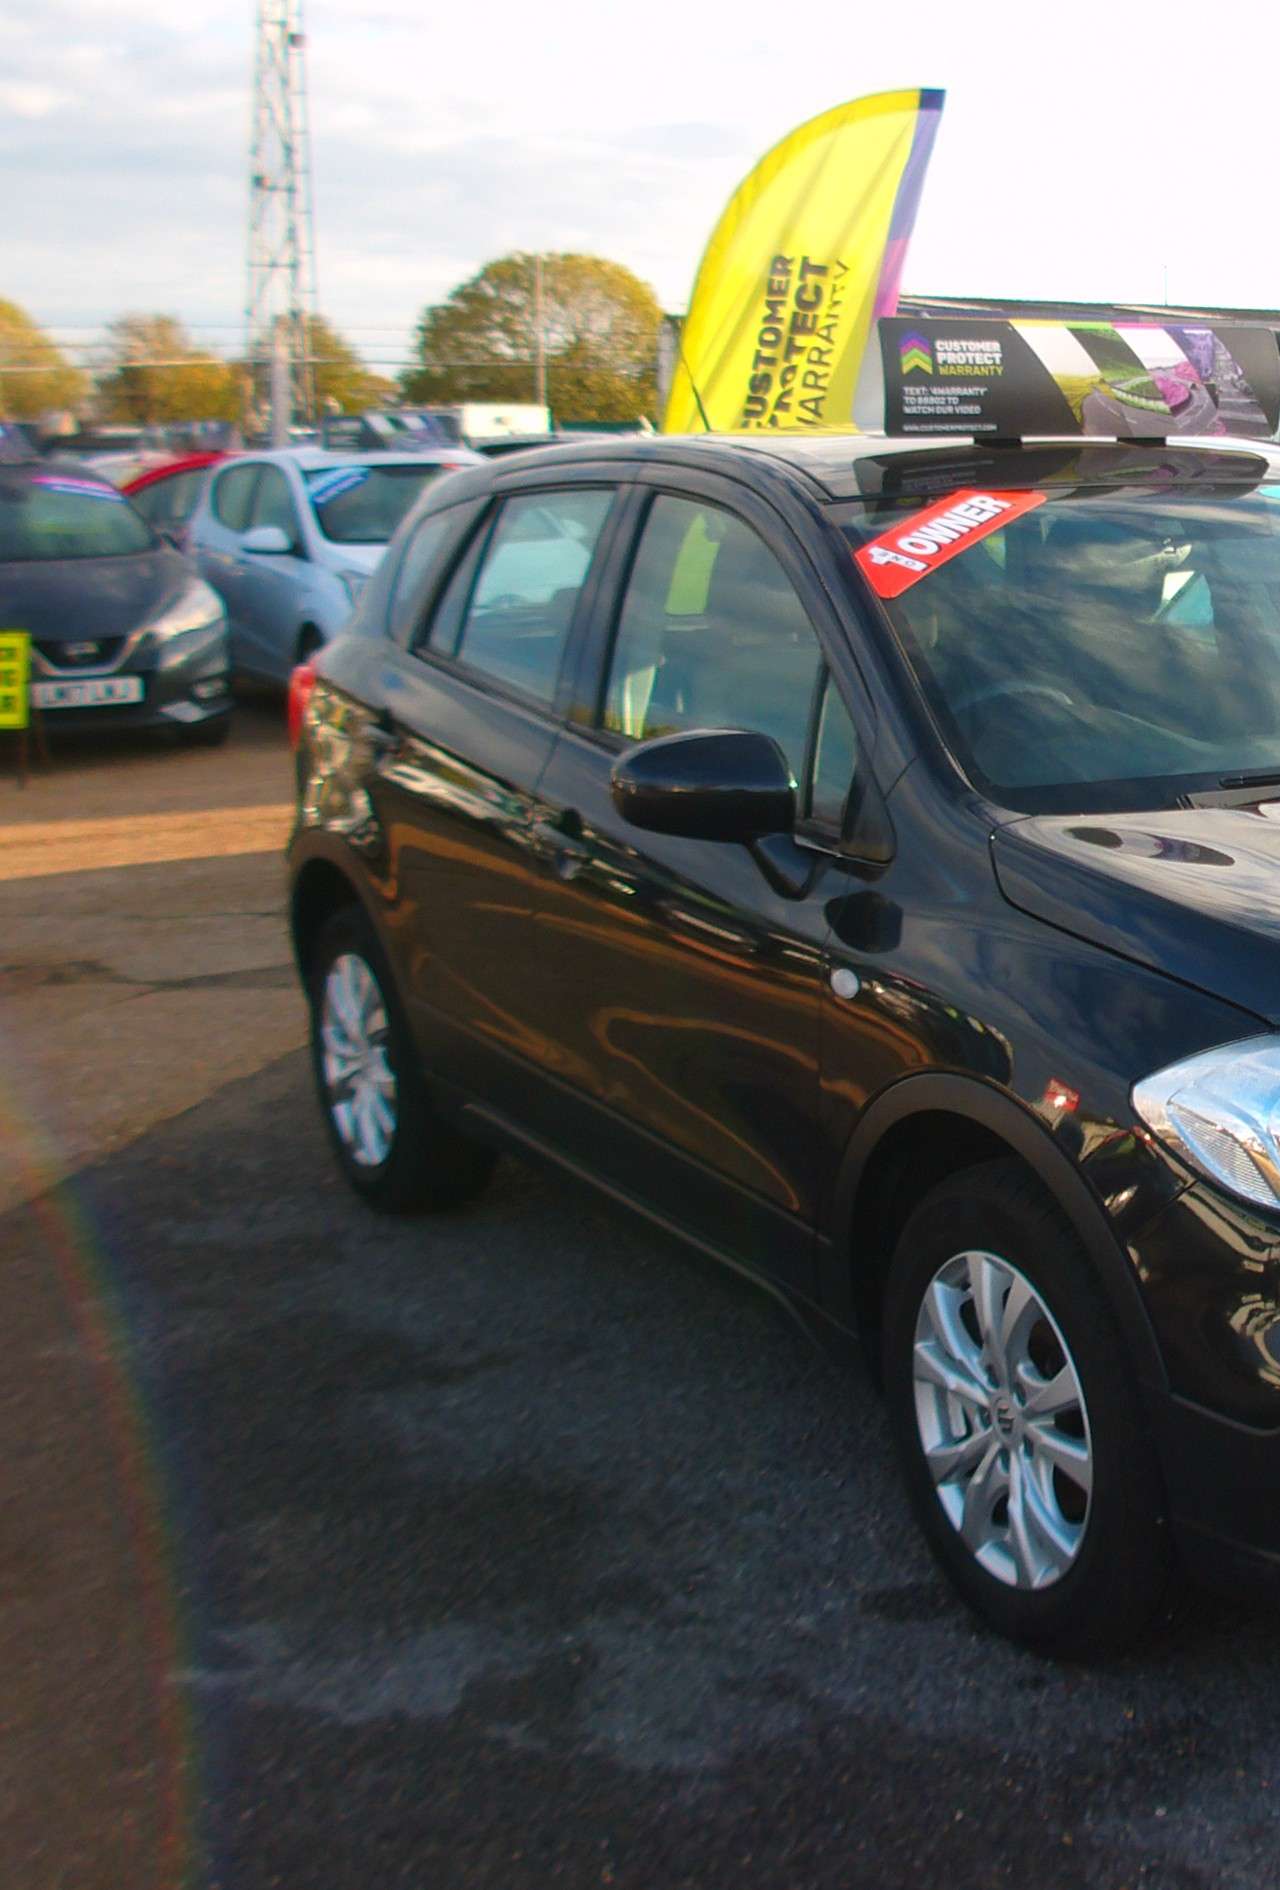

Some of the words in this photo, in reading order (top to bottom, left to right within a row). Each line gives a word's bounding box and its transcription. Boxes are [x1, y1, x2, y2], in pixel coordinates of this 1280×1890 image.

[741, 255, 794, 428] USTOMER
[767, 256, 829, 428] ROTECT
[935, 340, 1001, 352] CUSTOMER
[936, 352, 1003, 364] PROTECT
[939, 365, 1004, 376] WARRANTY
[897, 495, 1013, 556] OWNER
